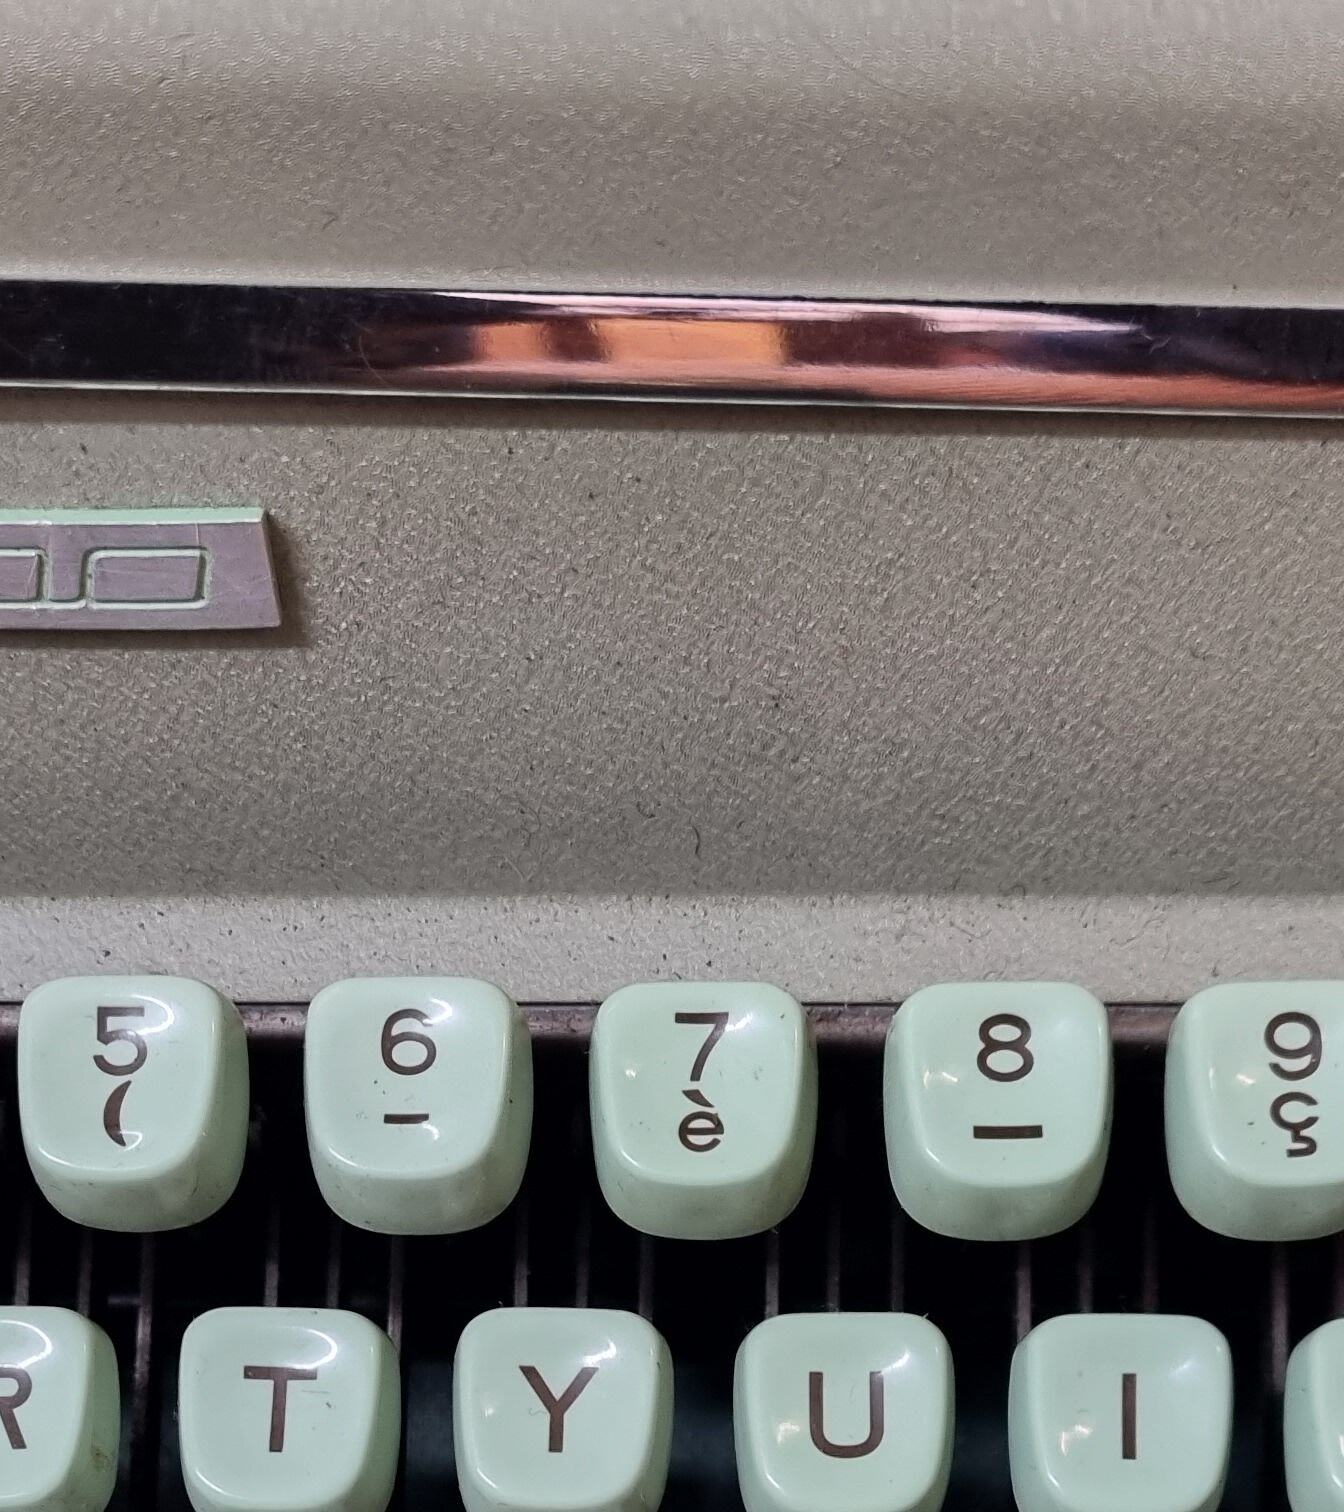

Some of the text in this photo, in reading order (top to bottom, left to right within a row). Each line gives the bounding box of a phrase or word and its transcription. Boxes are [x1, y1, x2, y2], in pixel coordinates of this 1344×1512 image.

[92, 1005, 148, 1076] 5
[380, 1008, 437, 1076] 6
[674, 1011, 731, 1083] 7
[976, 1013, 1034, 1083] 8
[1264, 1011, 1323, 1083] 9
[677, 1088, 725, 1153] è
[1268, 1089, 1320, 1159] ç
[243, 1365, 318, 1453] T
[518, 1364, 596, 1454] Y
[808, 1371, 885, 1459] U
[1121, 1372, 1137, 1461] I
